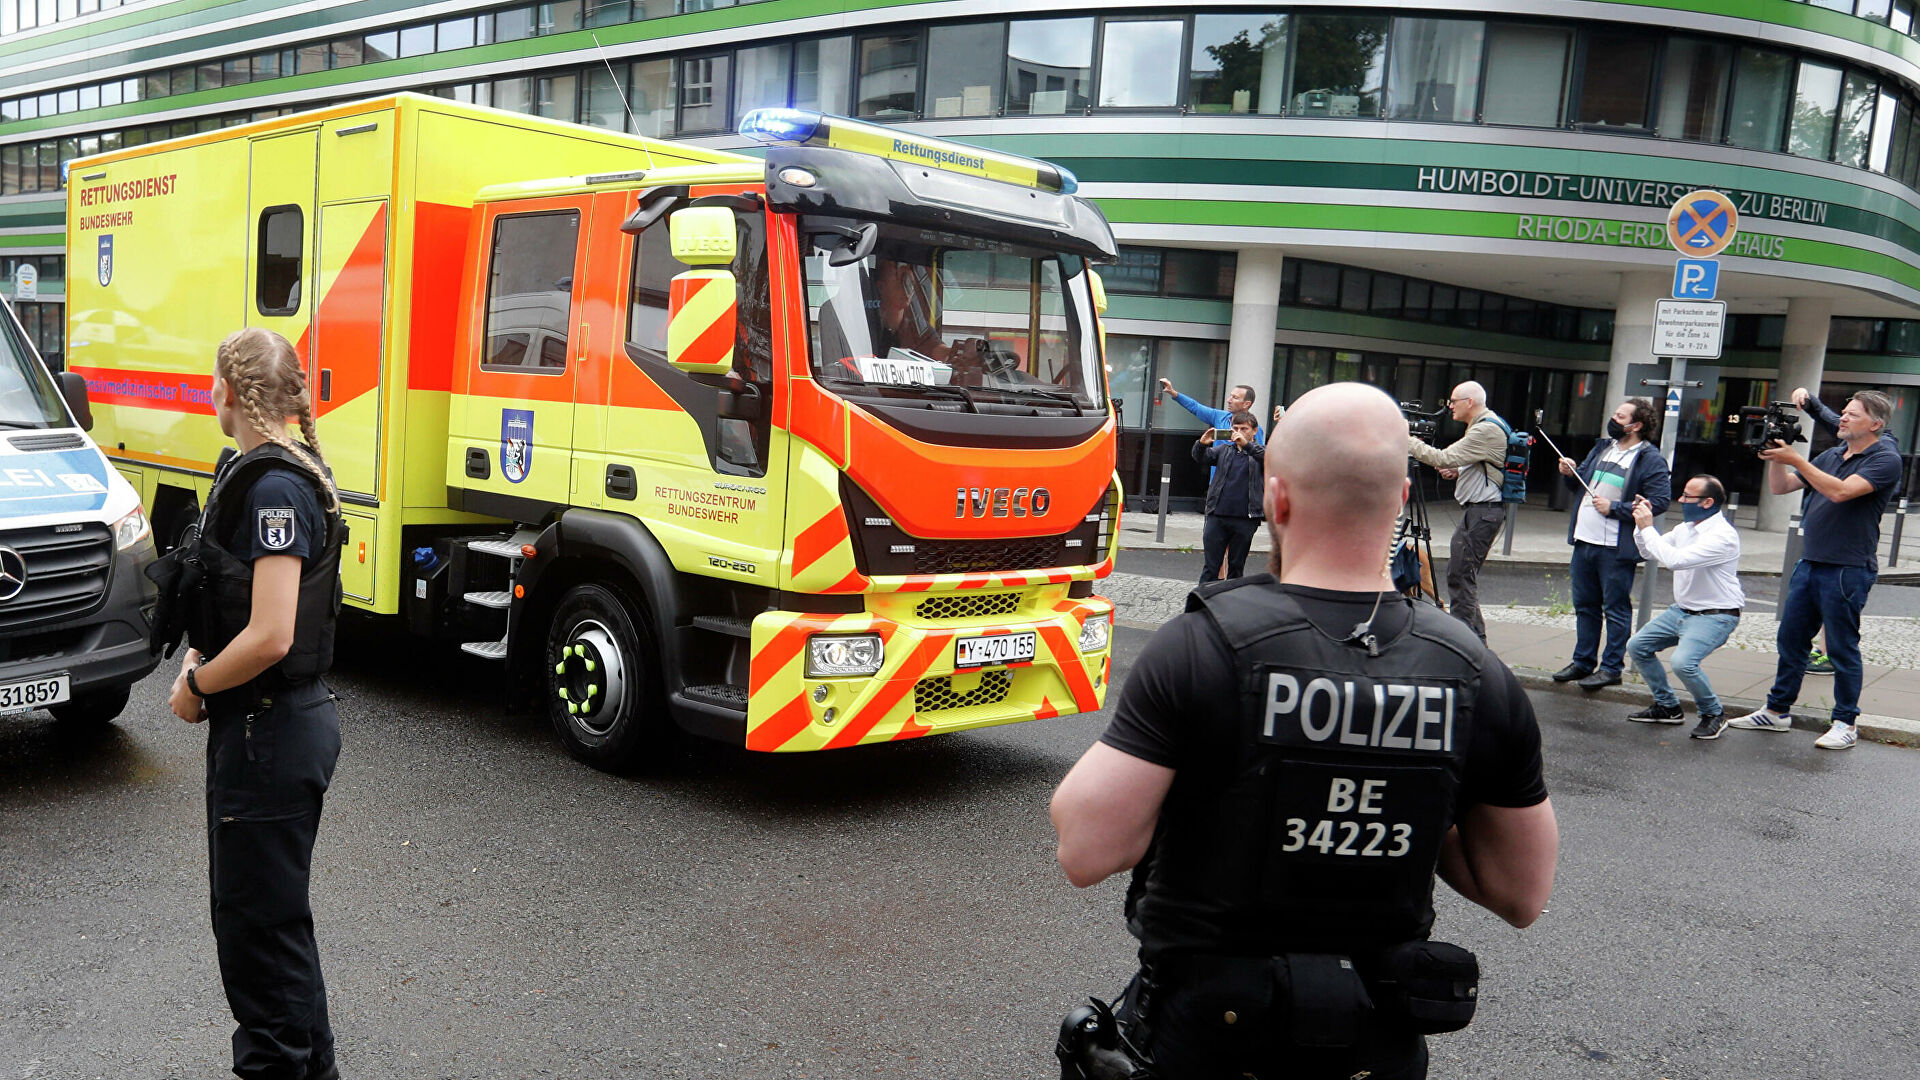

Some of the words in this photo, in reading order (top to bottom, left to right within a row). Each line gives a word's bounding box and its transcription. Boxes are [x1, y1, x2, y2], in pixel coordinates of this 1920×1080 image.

[893, 139, 984, 169] Rettungsdienst
[80, 174, 177, 207] RETTUNGSDIENST
[1417, 167, 1732, 206] HUMBOLDT-UNIVERS
[1738, 192, 1765, 215] ZU
[1769, 196, 1828, 223] BERLIN
[80, 211, 133, 230] BUNDESWEHR
[679, 236, 731, 251] IVECO
[1518, 215, 1784, 258] RHODA-ERD-HAUS
[1680, 264, 1705, 294] P
[1658, 319, 1719, 328] Bewohnerparkausweis
[1673, 308, 1703, 316] Parkschein
[1728, 414, 1740, 423] 13
[655, 486, 756, 511] RETTUNGSZENTRUM
[955, 487, 1051, 518] IVECO
[261, 510, 292, 519] POLIZEI
[668, 503, 739, 524] BUNDESWEHR
[708, 556, 756, 574] 120-250
[1013, 636, 1033, 656] 155
[0, 681, 60, 708] 31859
[1263, 672, 1456, 752] POLIZEI
[1327, 777, 1387, 815] BE
[1282, 817, 1413, 858] 34223
